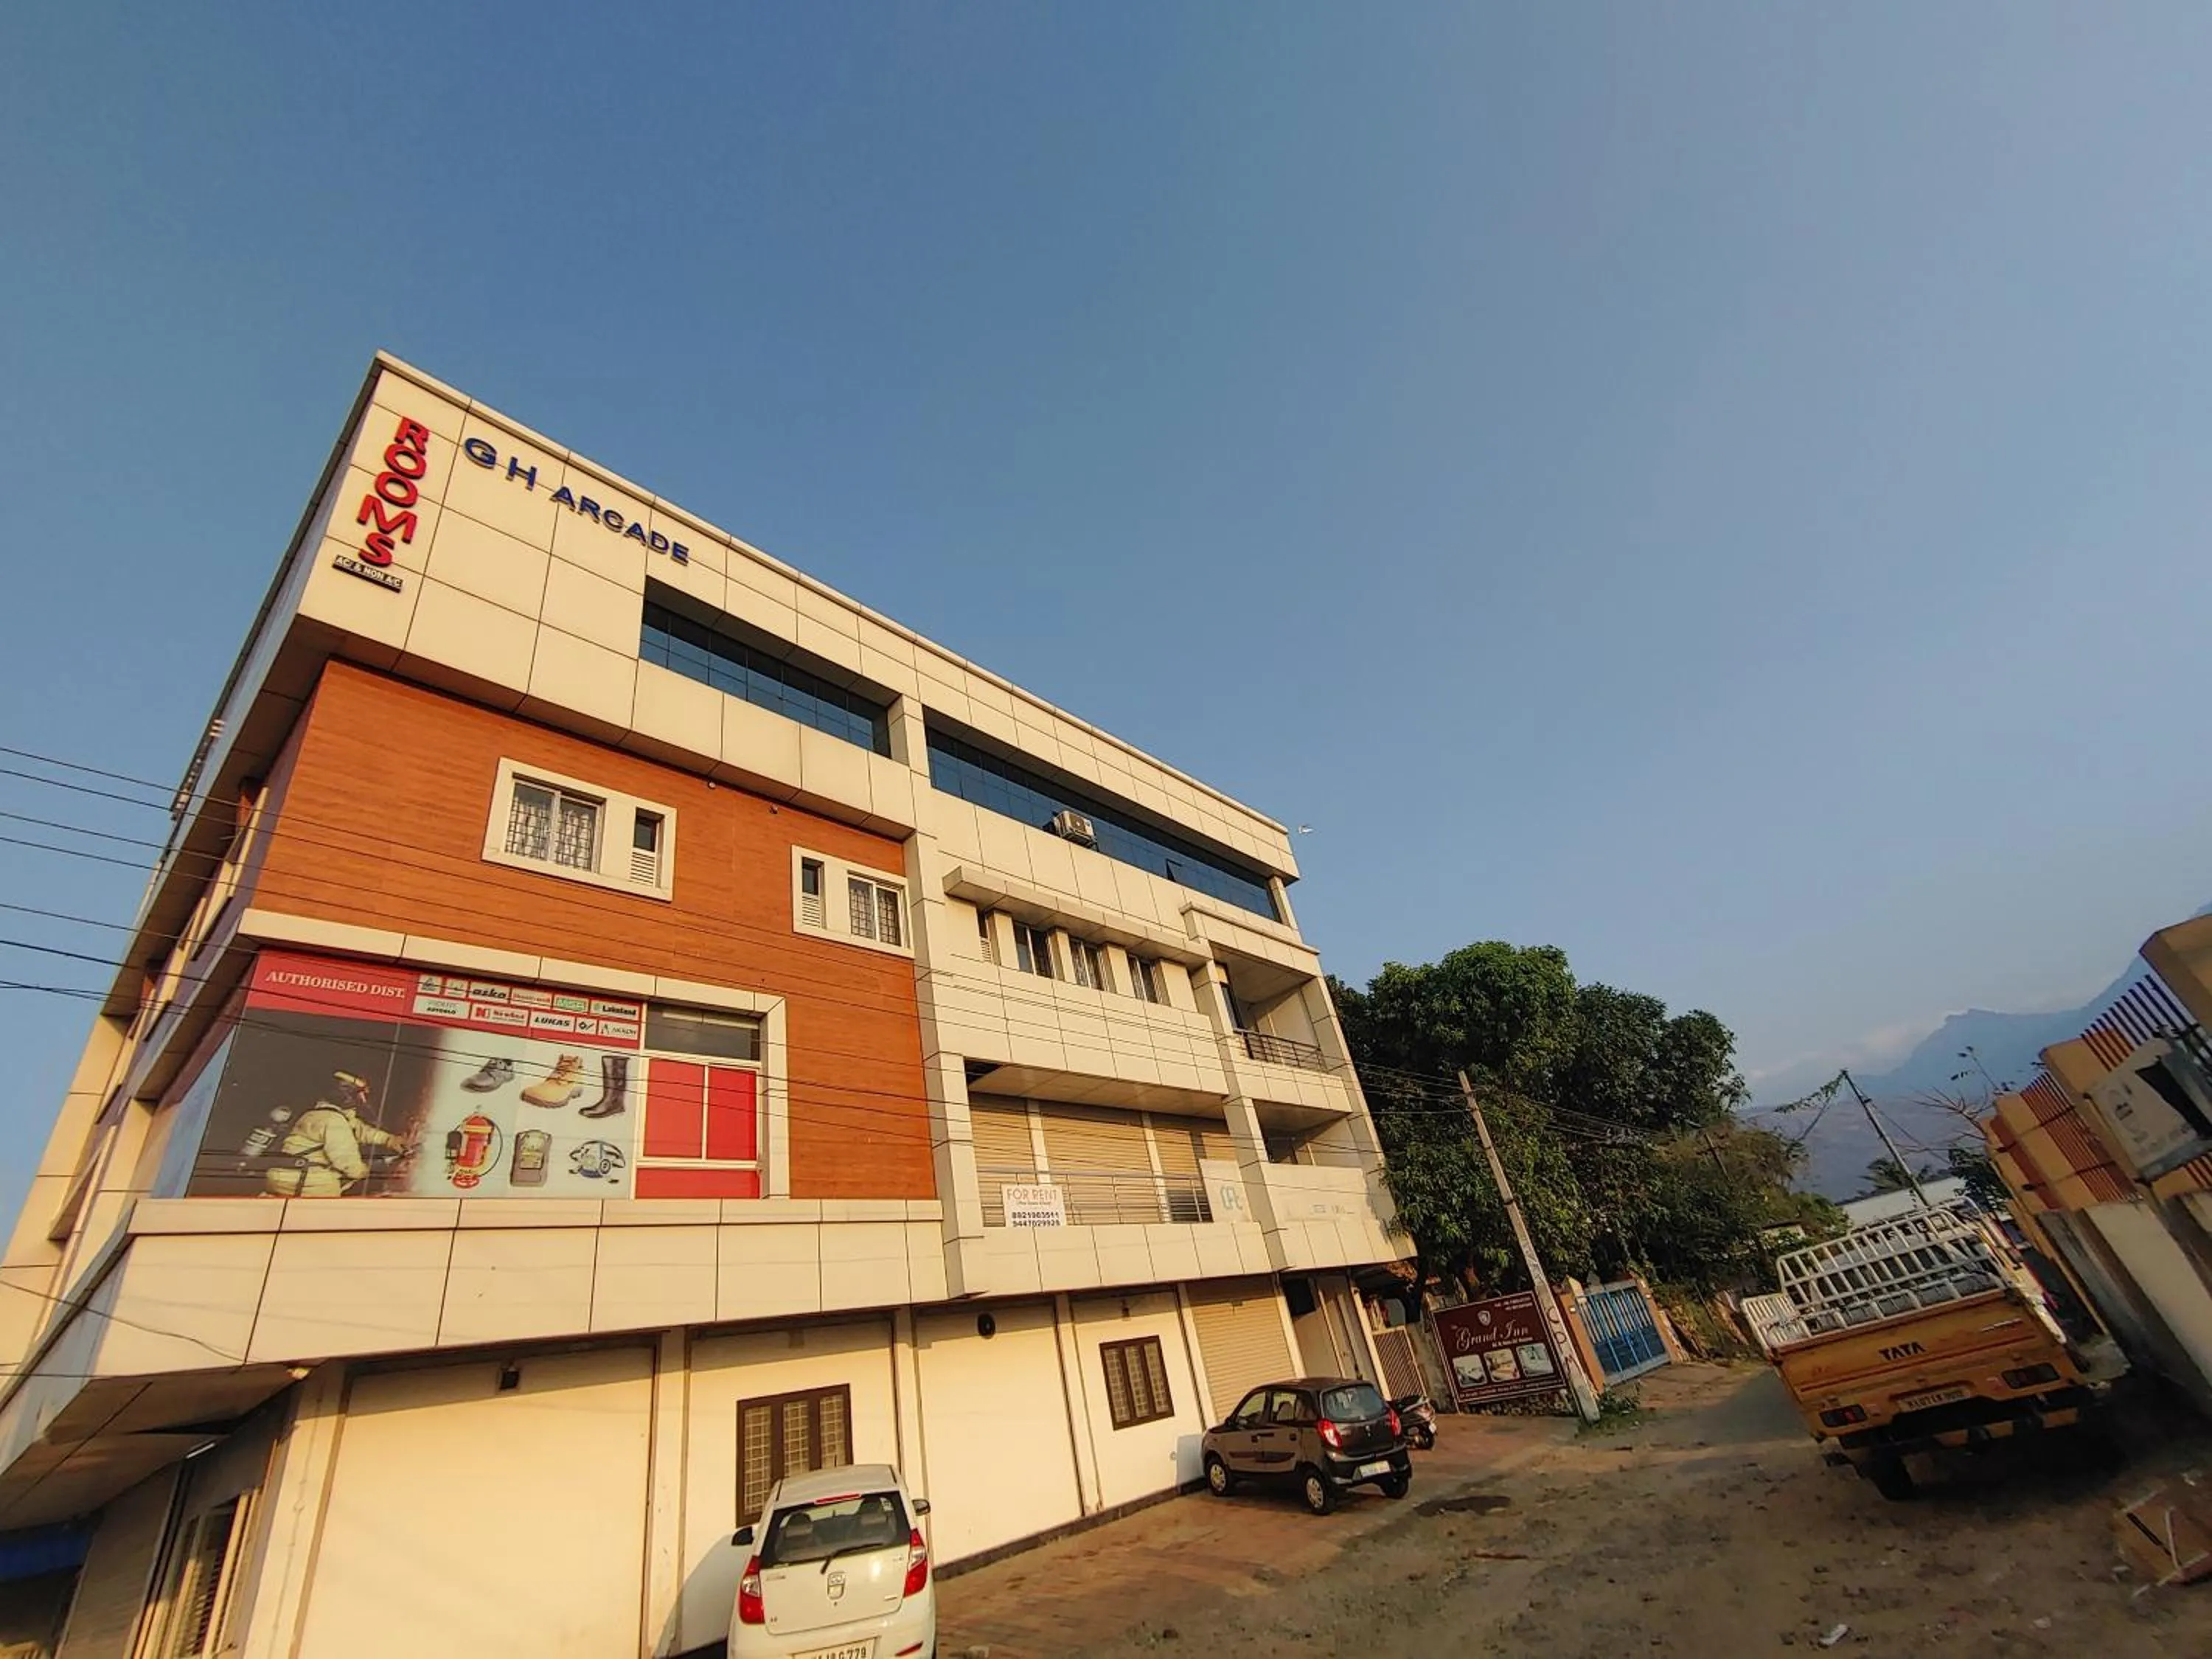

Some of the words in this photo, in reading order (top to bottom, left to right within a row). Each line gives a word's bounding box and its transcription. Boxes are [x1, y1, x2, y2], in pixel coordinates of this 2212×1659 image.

[358, 417, 428, 567] ROOMS
[549, 486, 689, 566] ARCADE
[364, 567, 384, 579] NON
[265, 971, 368, 993] AUTHORISED
[534, 1016, 570, 1027] LUKAS
[1006, 1188, 1028, 1200] FOR
[1032, 1189, 1057, 1200] RENT
[1455, 1326, 1498, 1351] Grand
[1878, 1341, 1927, 1360] TATA
